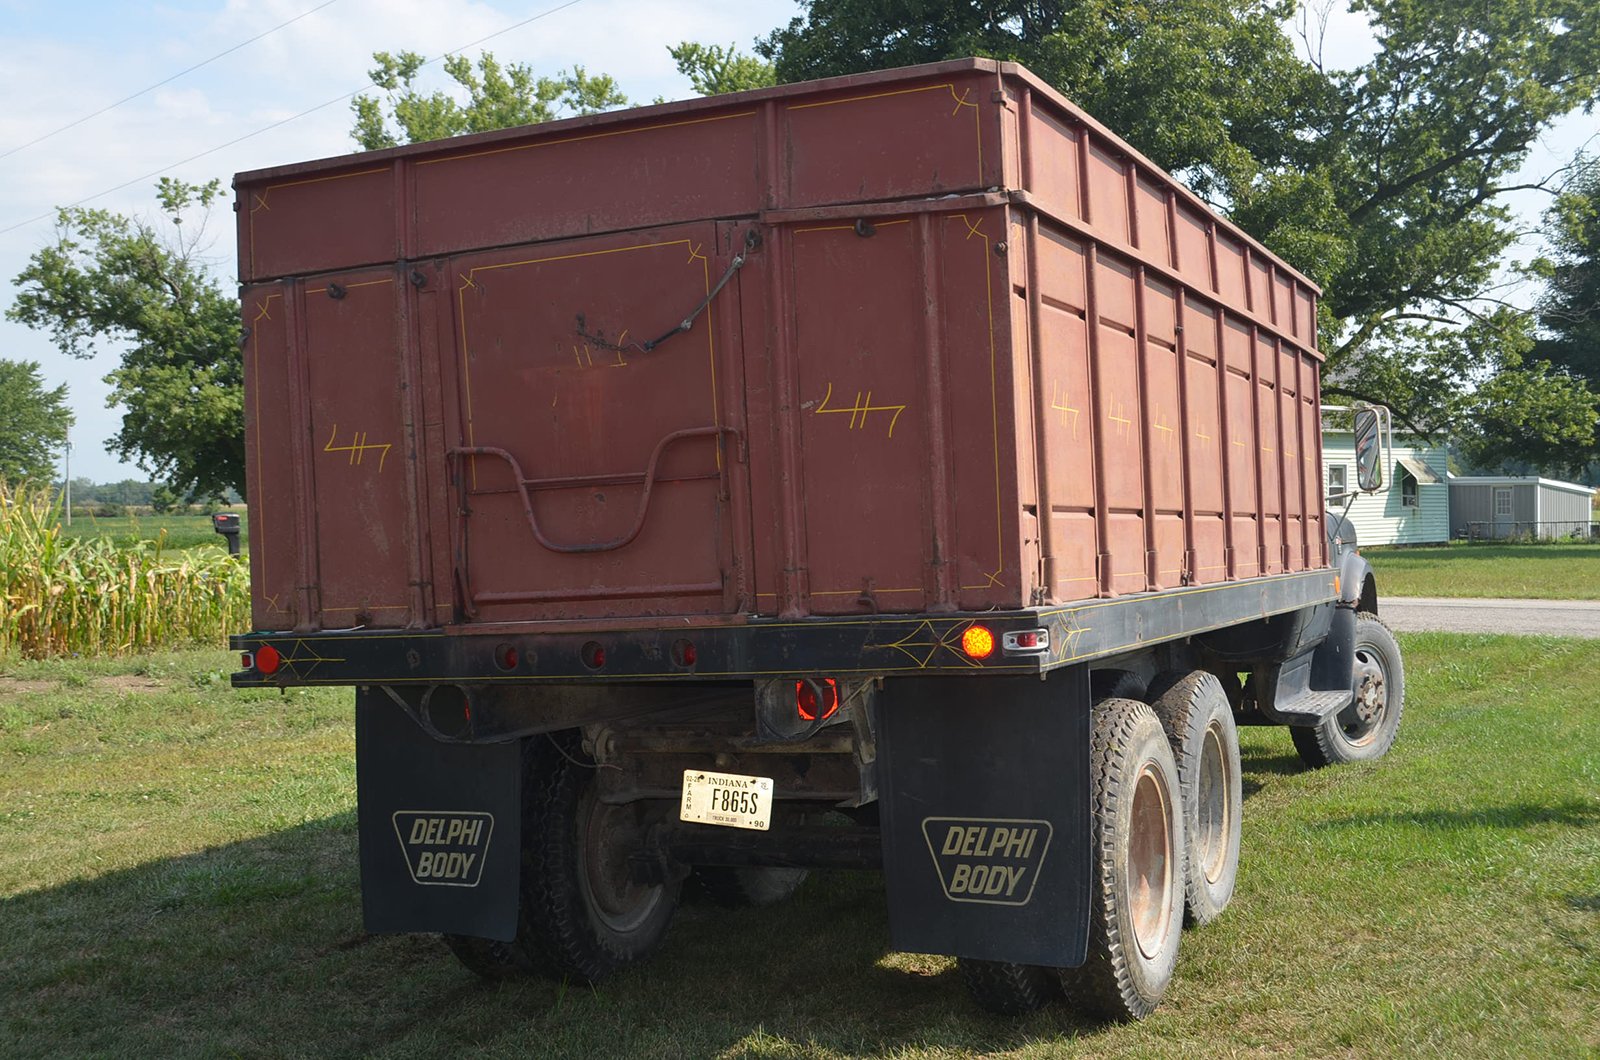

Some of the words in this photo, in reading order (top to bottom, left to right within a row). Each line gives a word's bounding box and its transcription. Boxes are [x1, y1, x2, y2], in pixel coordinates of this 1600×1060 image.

[708, 777, 748, 789] INDIANA
[712, 788, 758, 815] F865S
[408, 818, 484, 846] DELPHI
[754, 820, 765, 828] 90
[941, 826, 1038, 858] DELPHI
[416, 851, 476, 879] BODY
[949, 863, 1027, 896] BODY
